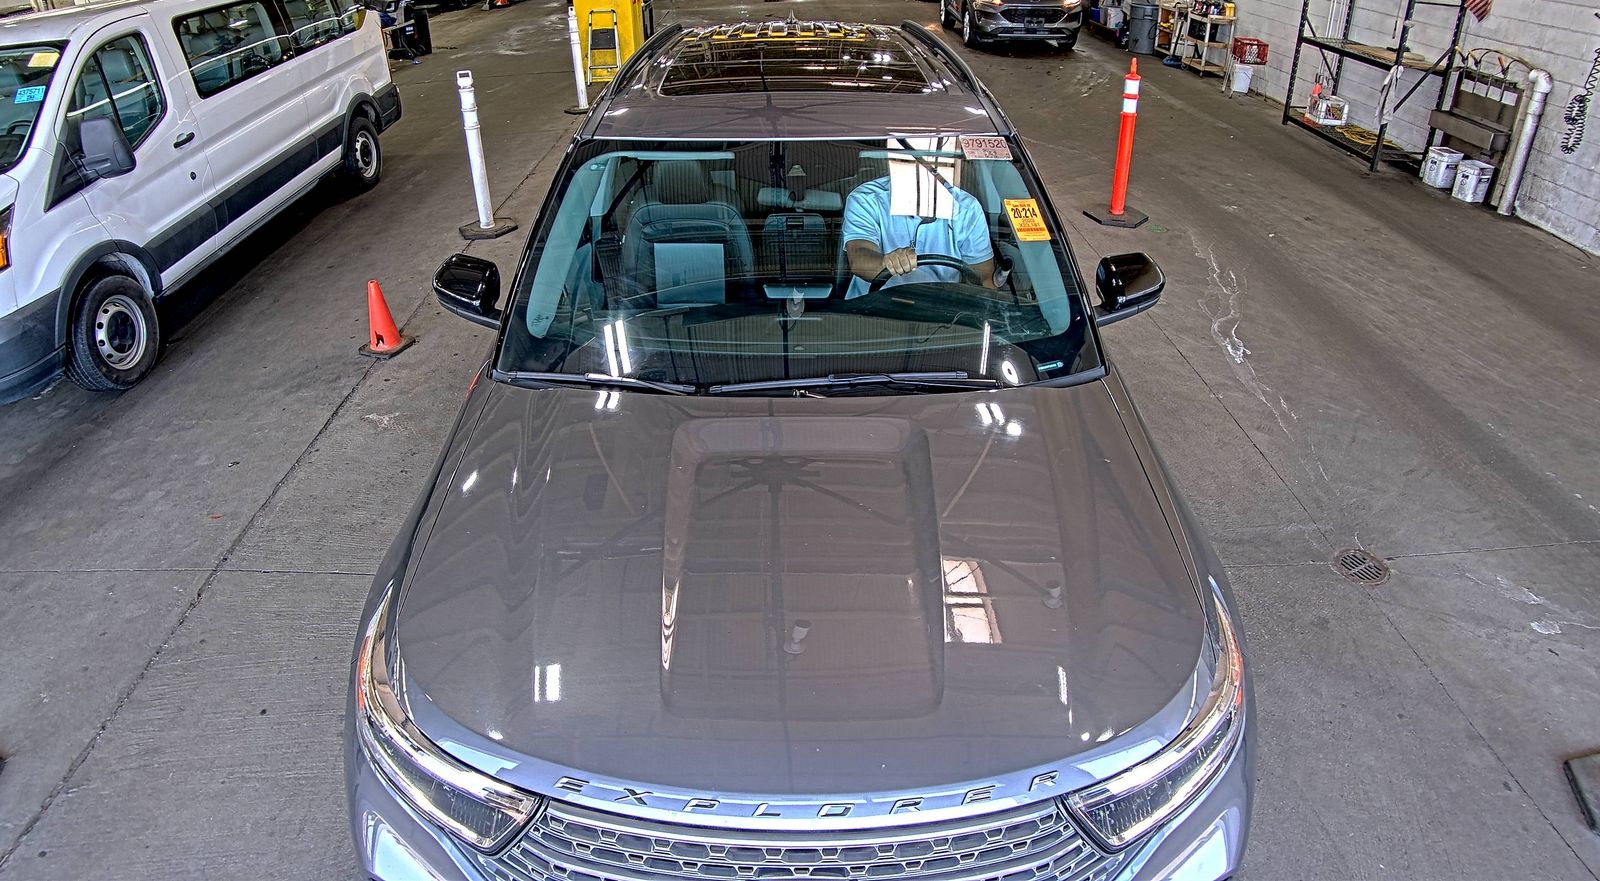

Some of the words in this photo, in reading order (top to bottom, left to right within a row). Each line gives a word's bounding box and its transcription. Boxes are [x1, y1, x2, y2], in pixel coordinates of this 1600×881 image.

[963, 139, 1007, 148] 9791520
[1011, 207, 1037, 218] 20:214
[553, 770, 1059, 818] EXPLORER
